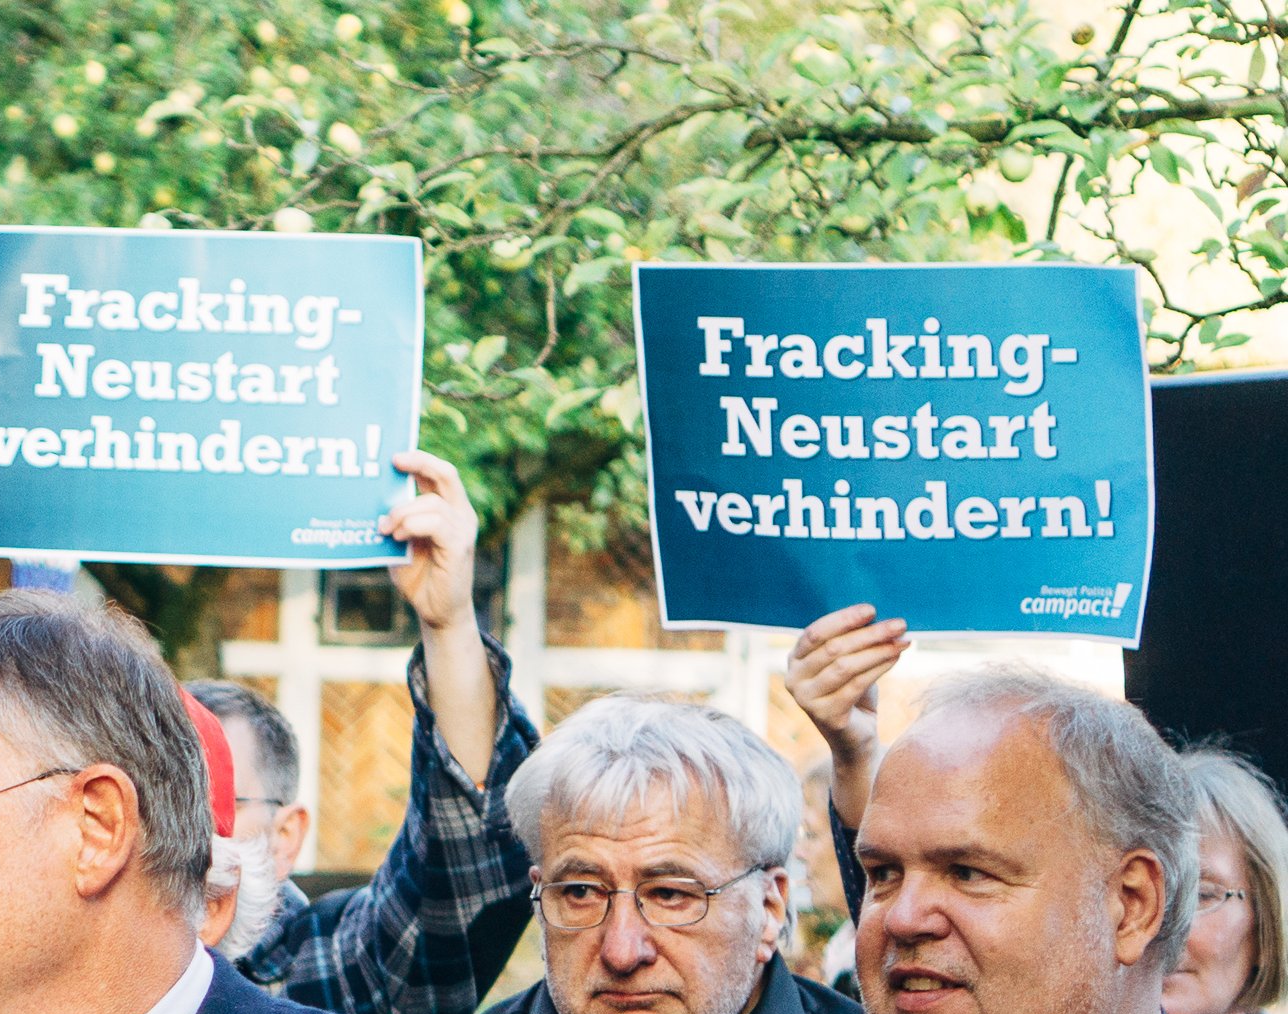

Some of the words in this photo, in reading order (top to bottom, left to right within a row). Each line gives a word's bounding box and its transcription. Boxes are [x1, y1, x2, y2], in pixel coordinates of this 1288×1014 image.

[18, 272, 363, 350] Fracking-
[34, 342, 342, 406] Neustart
[697, 316, 1078, 396] Fracking-
[720, 396, 1058, 460] Neustart
[675, 478, 1115, 540] verhindern!
[1020, 582, 1134, 620] campact!
[1040, 585, 1078, 597] Bewegt
[1080, 585, 1114, 597] Politik
